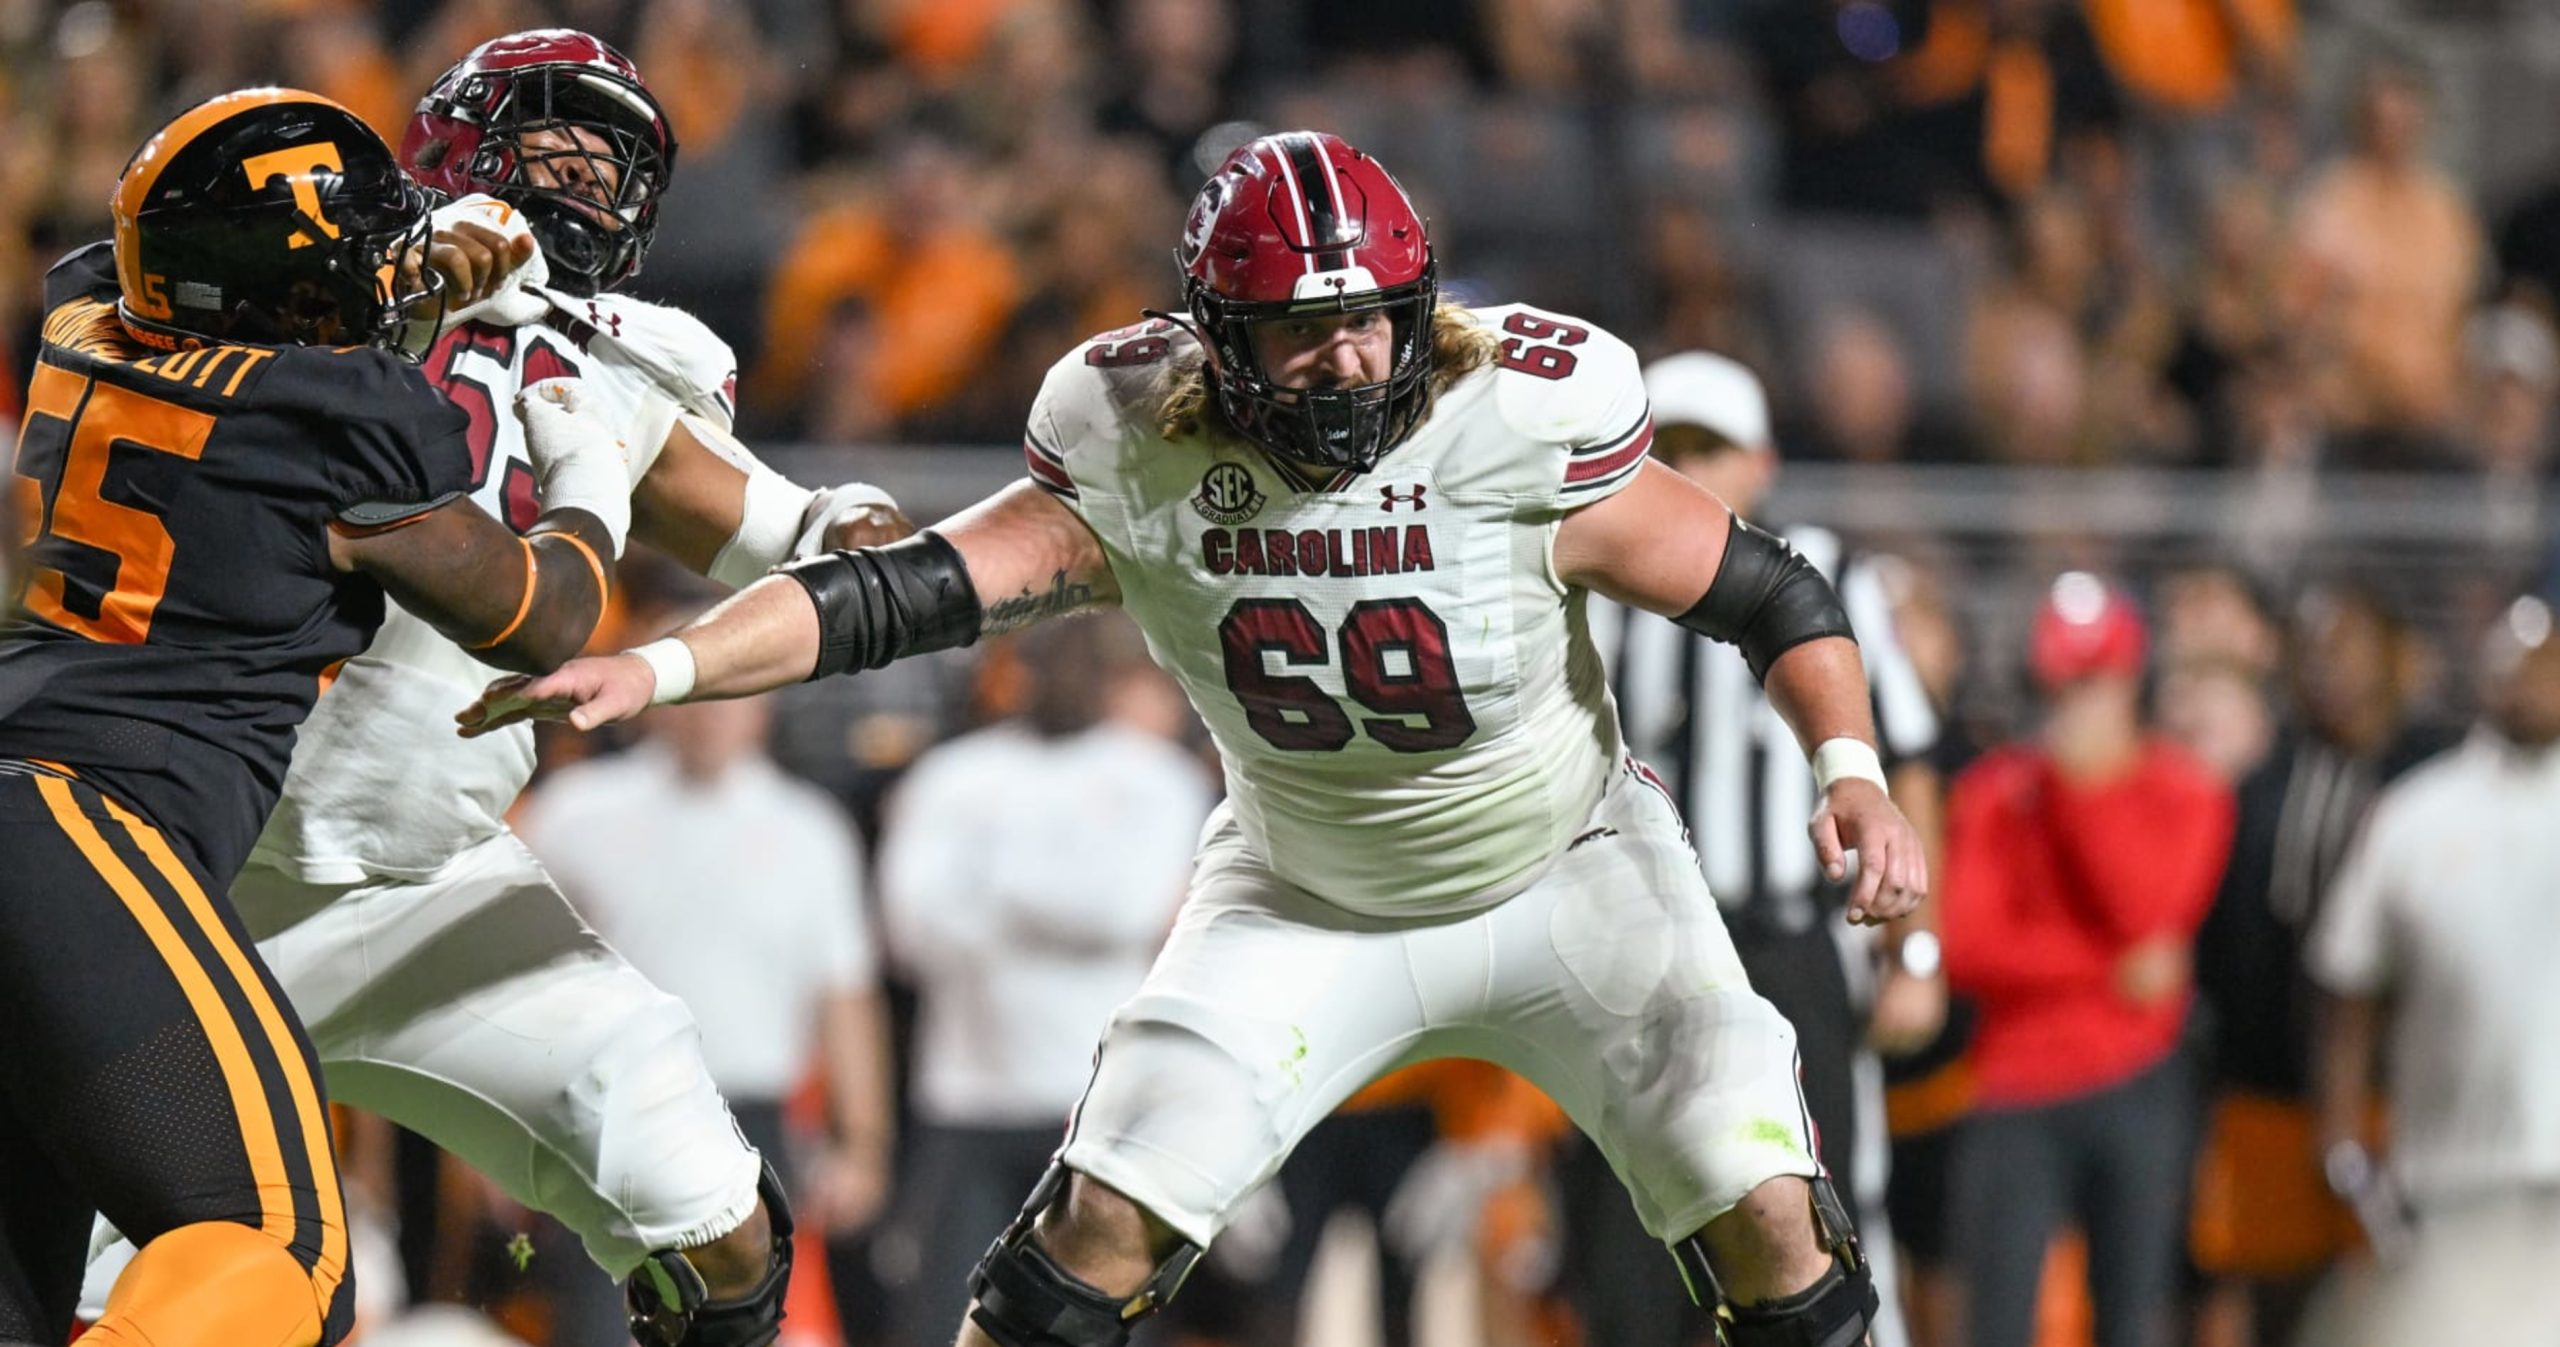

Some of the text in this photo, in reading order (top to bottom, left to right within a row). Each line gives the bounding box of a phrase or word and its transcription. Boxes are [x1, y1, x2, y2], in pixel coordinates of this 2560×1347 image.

[242, 141, 344, 250] T
[143, 273, 174, 320] 5
[1497, 311, 1590, 381] 69
[6, 360, 217, 645] 55
[1201, 502, 1259, 523] GRADUATE
[1206, 465, 1250, 508] SEC
[1201, 524, 1435, 578] CAROLINA
[1218, 596, 1477, 753] 69
